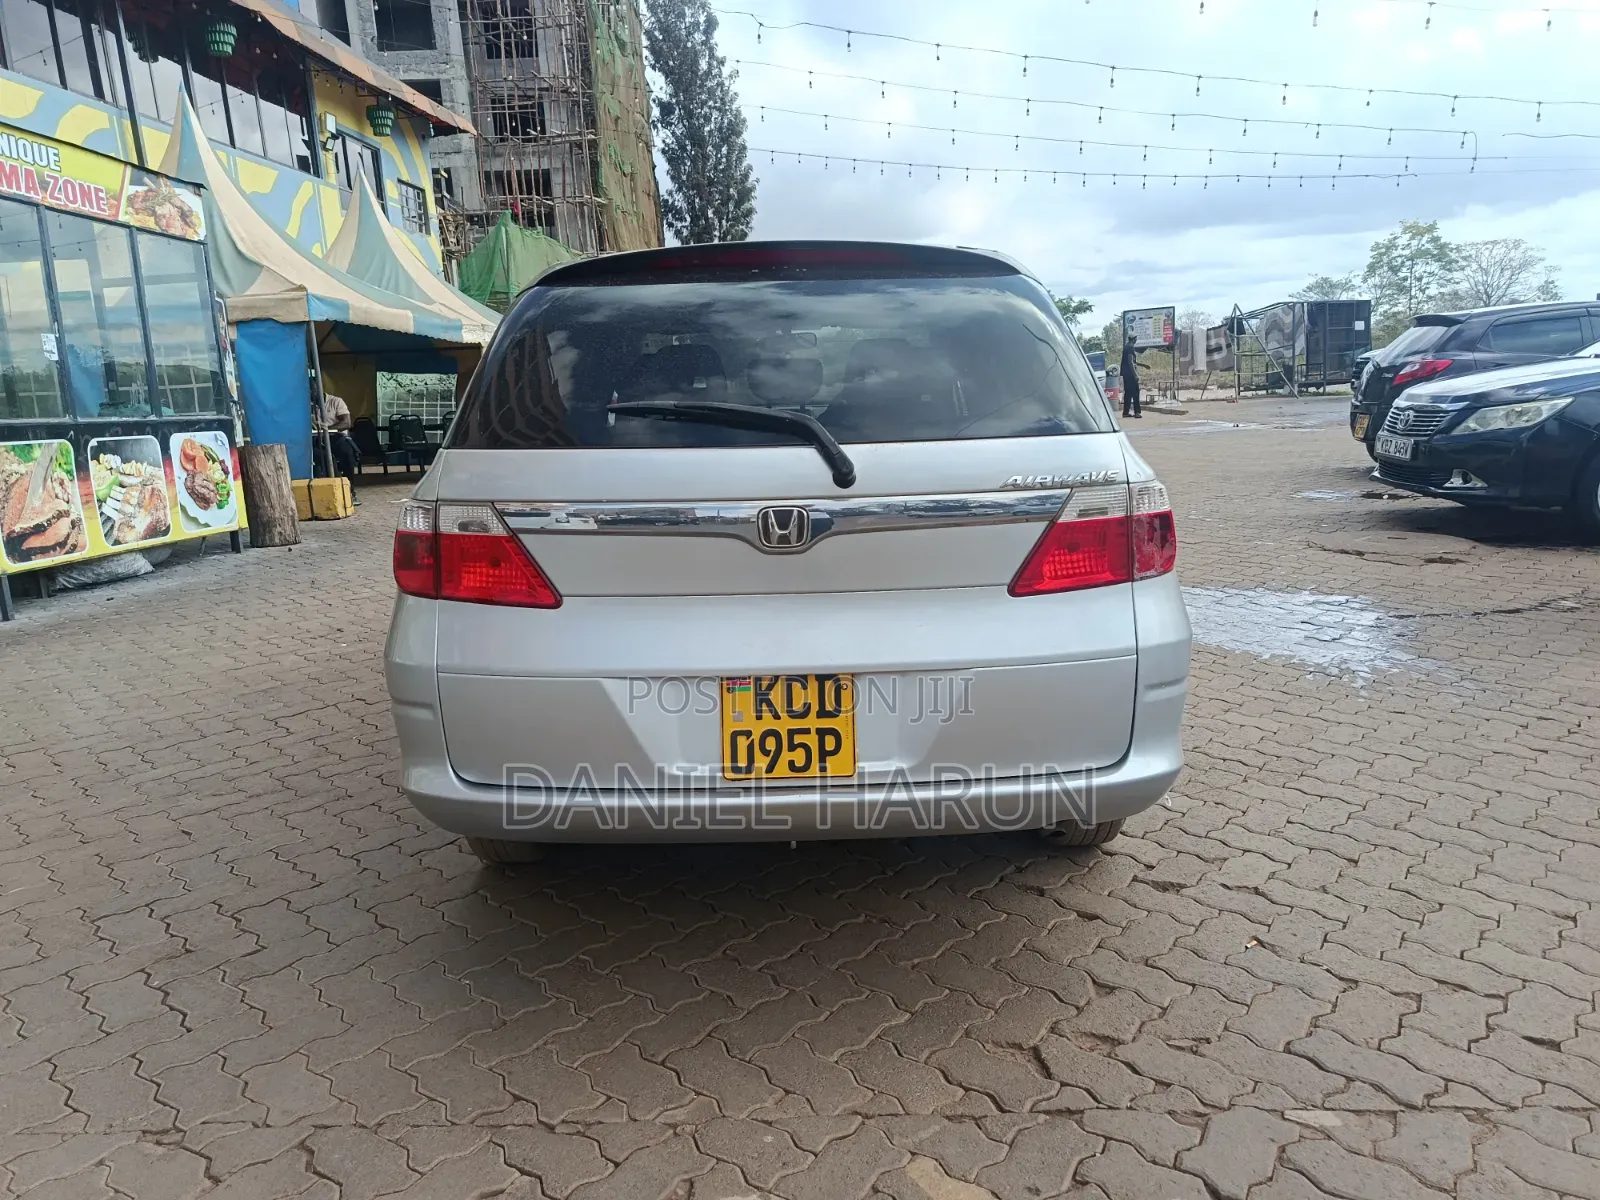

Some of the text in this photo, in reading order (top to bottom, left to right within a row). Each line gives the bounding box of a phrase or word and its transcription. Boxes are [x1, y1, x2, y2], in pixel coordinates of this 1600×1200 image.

[45, 172, 108, 214] ZONE
[999, 469, 1119, 488] AIRWAVE
[755, 675, 842, 720] KCD
[730, 727, 843, 774] 095P
